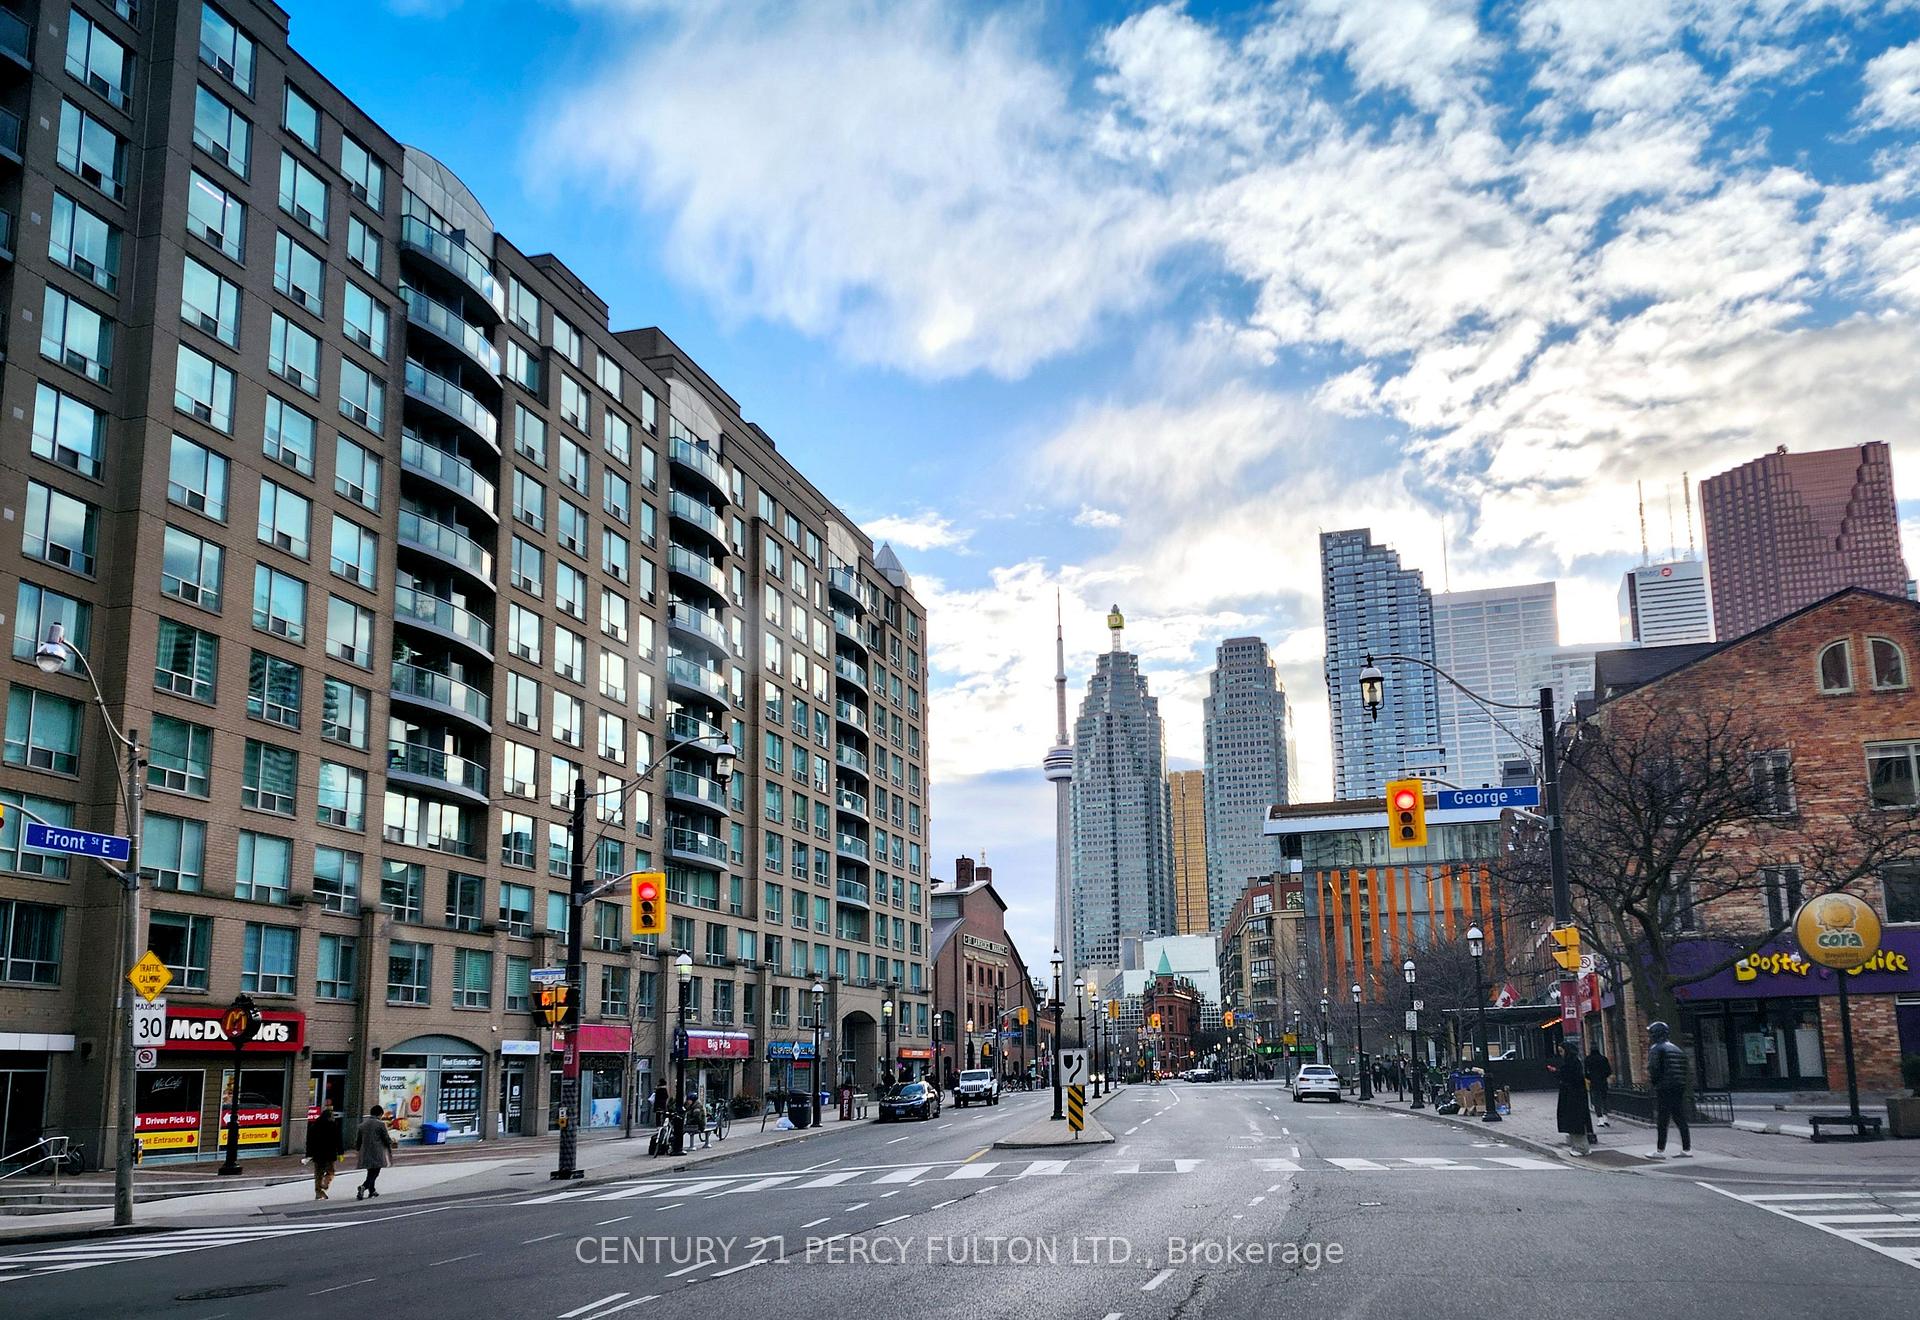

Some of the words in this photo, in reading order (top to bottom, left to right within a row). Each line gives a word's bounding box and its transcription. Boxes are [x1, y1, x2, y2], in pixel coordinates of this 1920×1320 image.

[1454, 791, 1508, 806] George
[46, 829, 85, 850] Front
[91, 837, 99, 845] St
[101, 839, 111, 854] E
[1818, 933, 1863, 947] cora
[140, 964, 160, 972] TRAFFIC
[139, 975, 161, 983] CALMING
[143, 986, 156, 994] ZONE
[139, 1017, 162, 1038] 30
[707, 1039, 718, 1051] Big
[453, 1058, 467, 1066] Estate
[468, 1058, 481, 1066] Office
[270, 1112, 279, 1120] Up
[145, 1117, 168, 1125] Driver
[169, 1116, 185, 1124] Pick
[186, 1116, 196, 1125] Up
[154, 1136, 183, 1144] Entrance
[242, 1132, 268, 1140] Entrance
